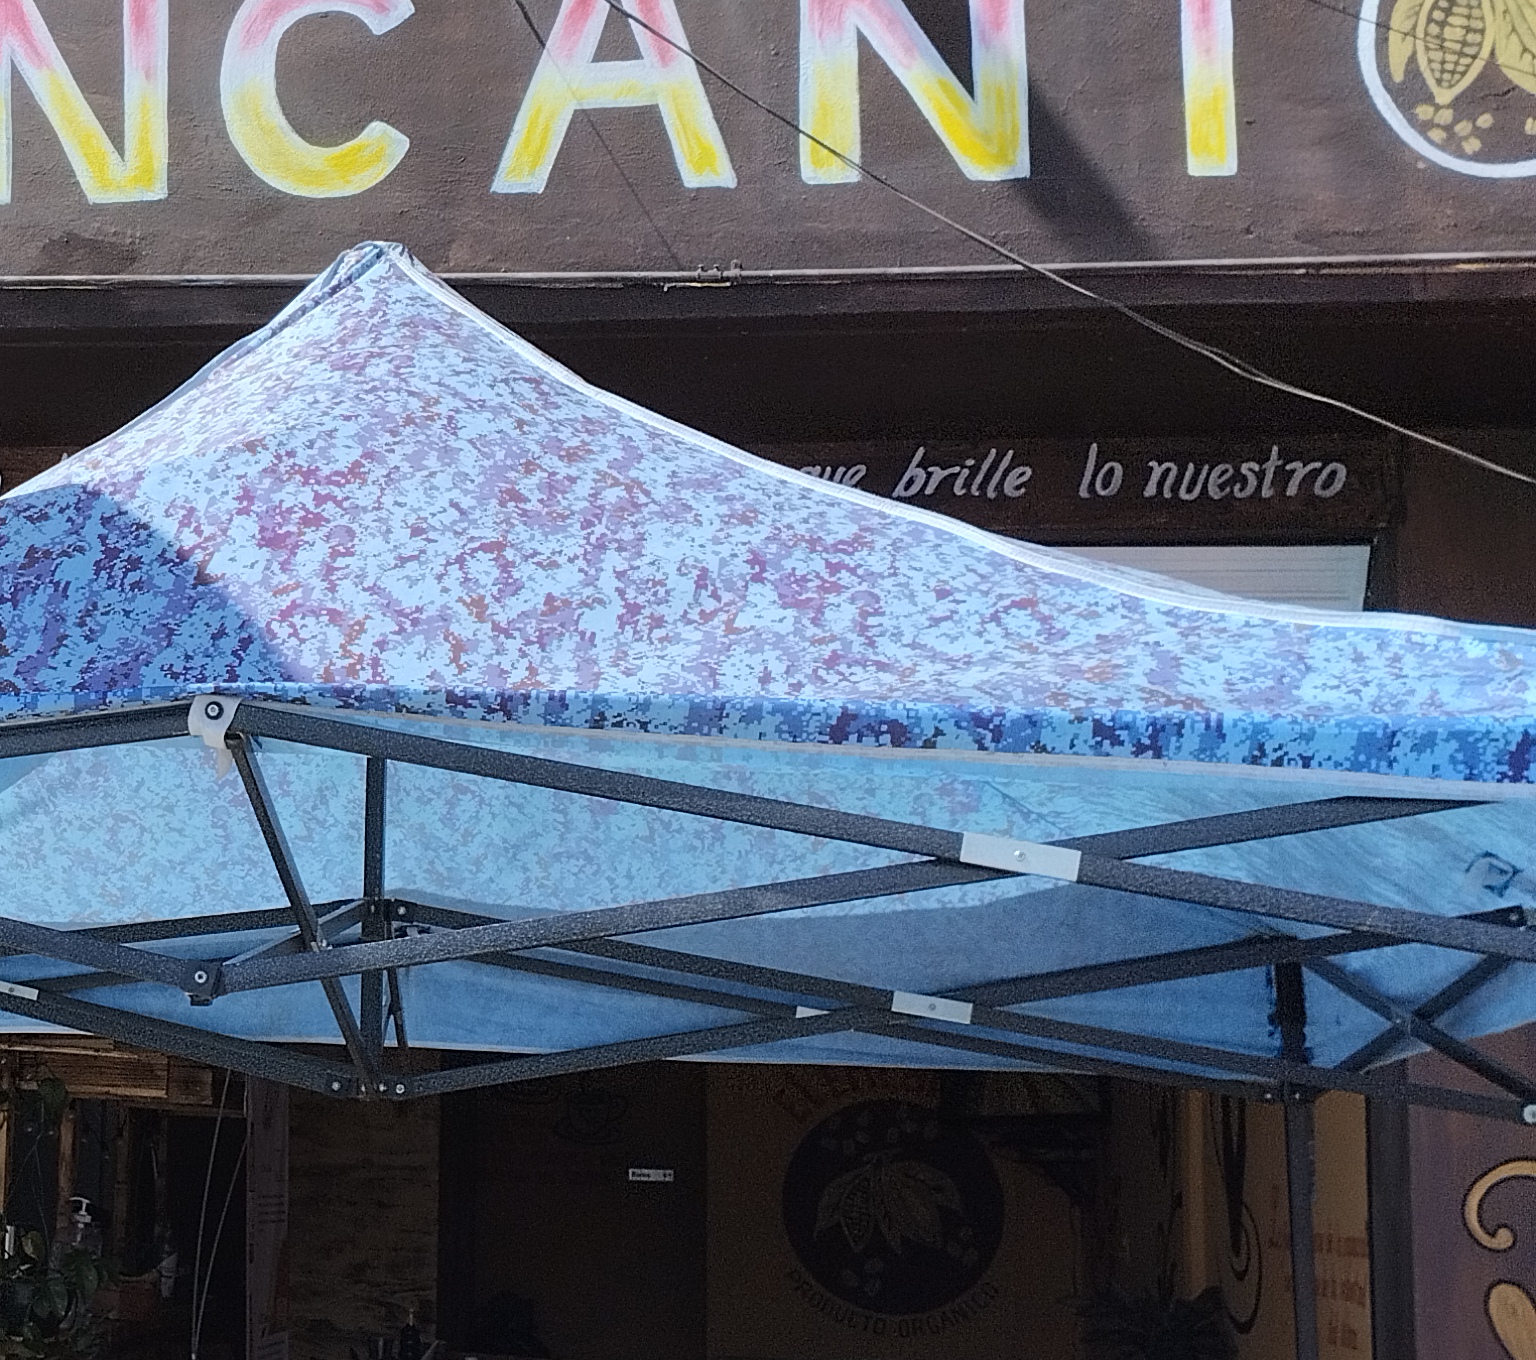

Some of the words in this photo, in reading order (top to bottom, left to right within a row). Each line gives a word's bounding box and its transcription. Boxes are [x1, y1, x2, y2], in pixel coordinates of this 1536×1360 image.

[892, 446, 1033, 499] brille
[1079, 442, 1124, 500] lo
[1143, 443, 1348, 501] nuestro
